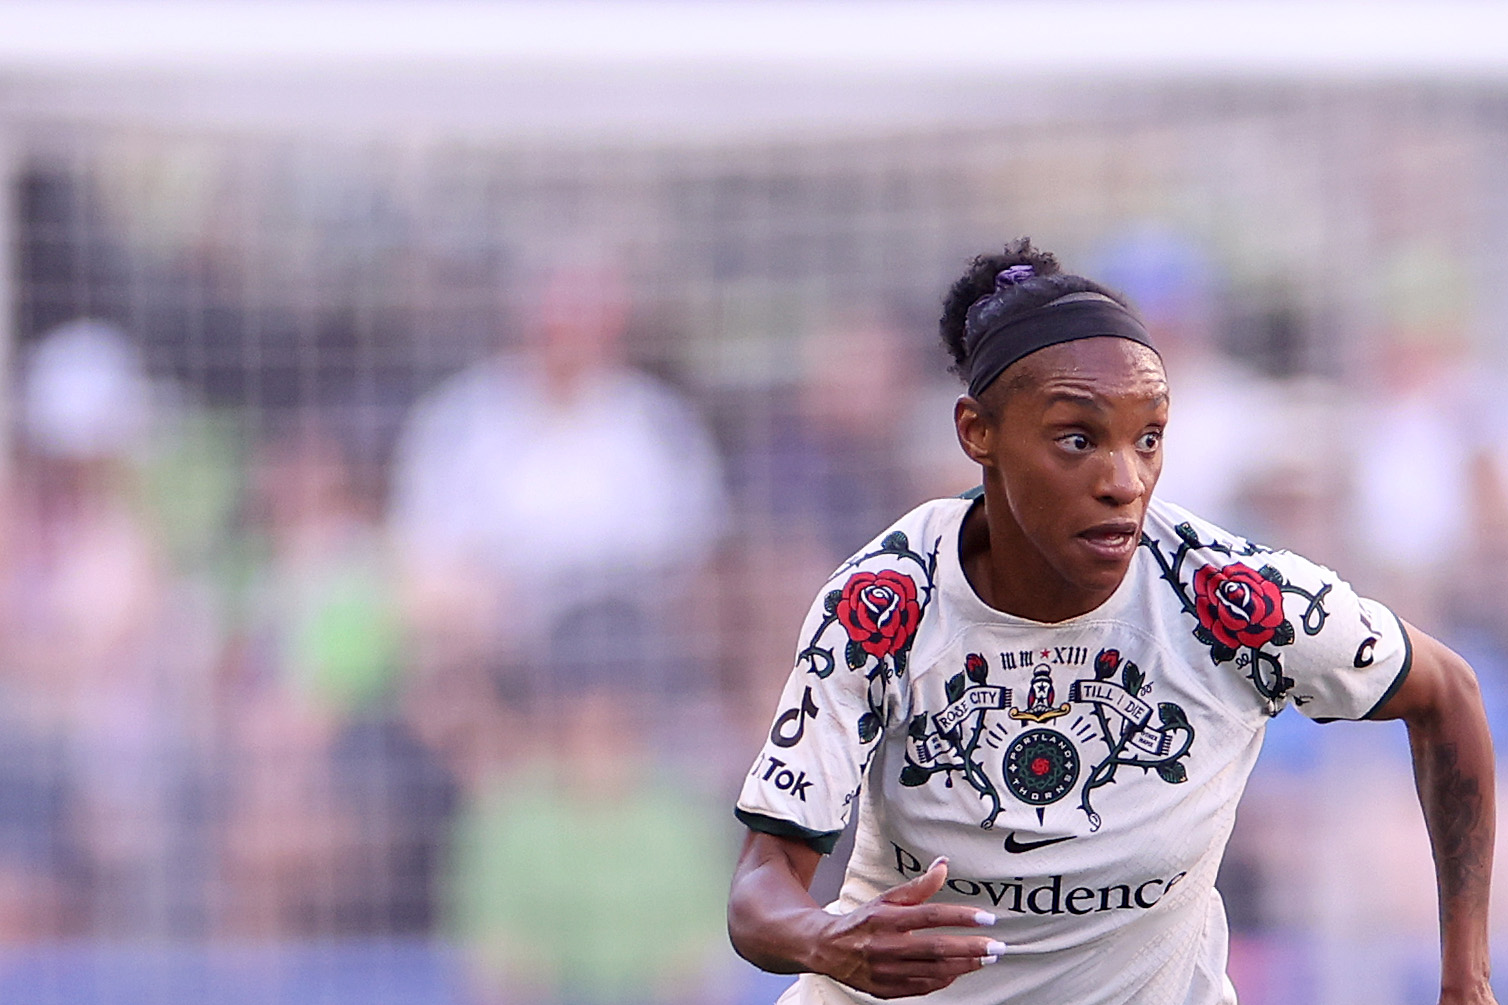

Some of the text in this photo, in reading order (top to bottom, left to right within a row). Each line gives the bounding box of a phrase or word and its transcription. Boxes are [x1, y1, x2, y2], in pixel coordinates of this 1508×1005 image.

[1051, 646, 1088, 666] XIII
[940, 691, 997, 729] ROSE CITY
[1083, 685, 1145, 720] TILL I DIE
[1010, 733, 1072, 760] PORTLAND
[1012, 773, 1073, 801] THORNS
[890, 841, 1187, 915] Povidence
